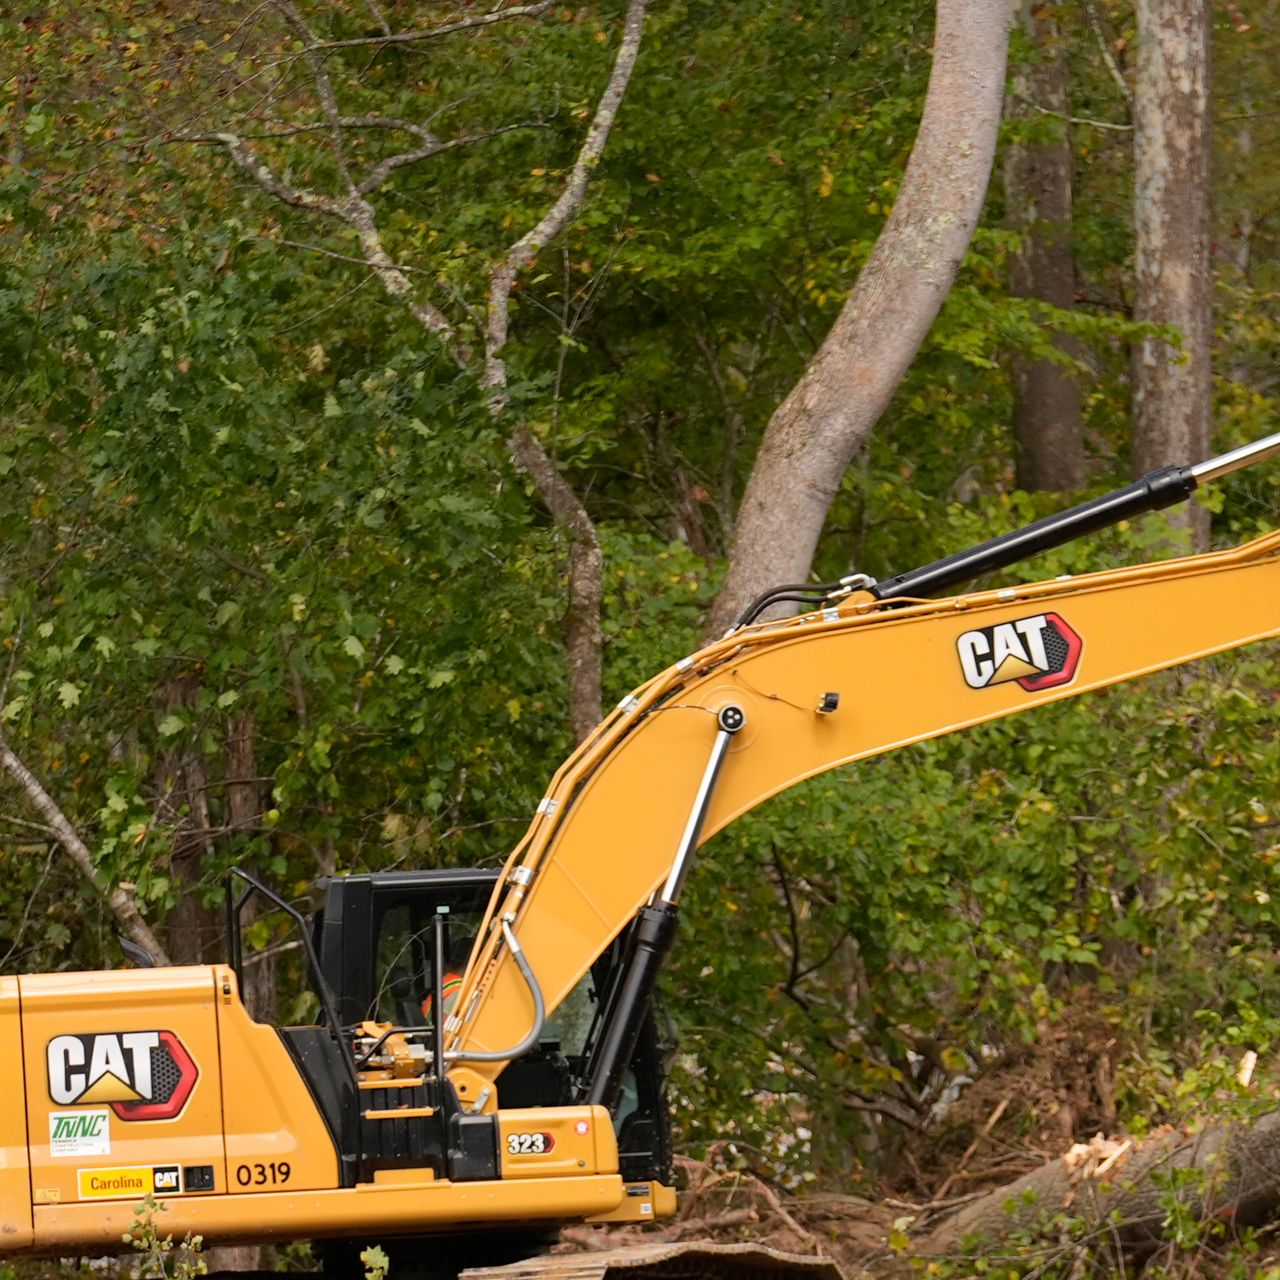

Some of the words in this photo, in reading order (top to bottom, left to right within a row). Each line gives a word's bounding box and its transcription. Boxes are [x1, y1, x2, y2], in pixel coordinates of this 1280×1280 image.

[957, 615, 1049, 688] CAT
[48, 1032, 159, 1104] CAT
[52, 1115, 107, 1139] TNNC
[507, 1133, 545, 1153] 323
[90, 1176, 143, 1191] Carolina
[154, 1171, 178, 1188] CAT
[236, 1162, 291, 1186] 0319
